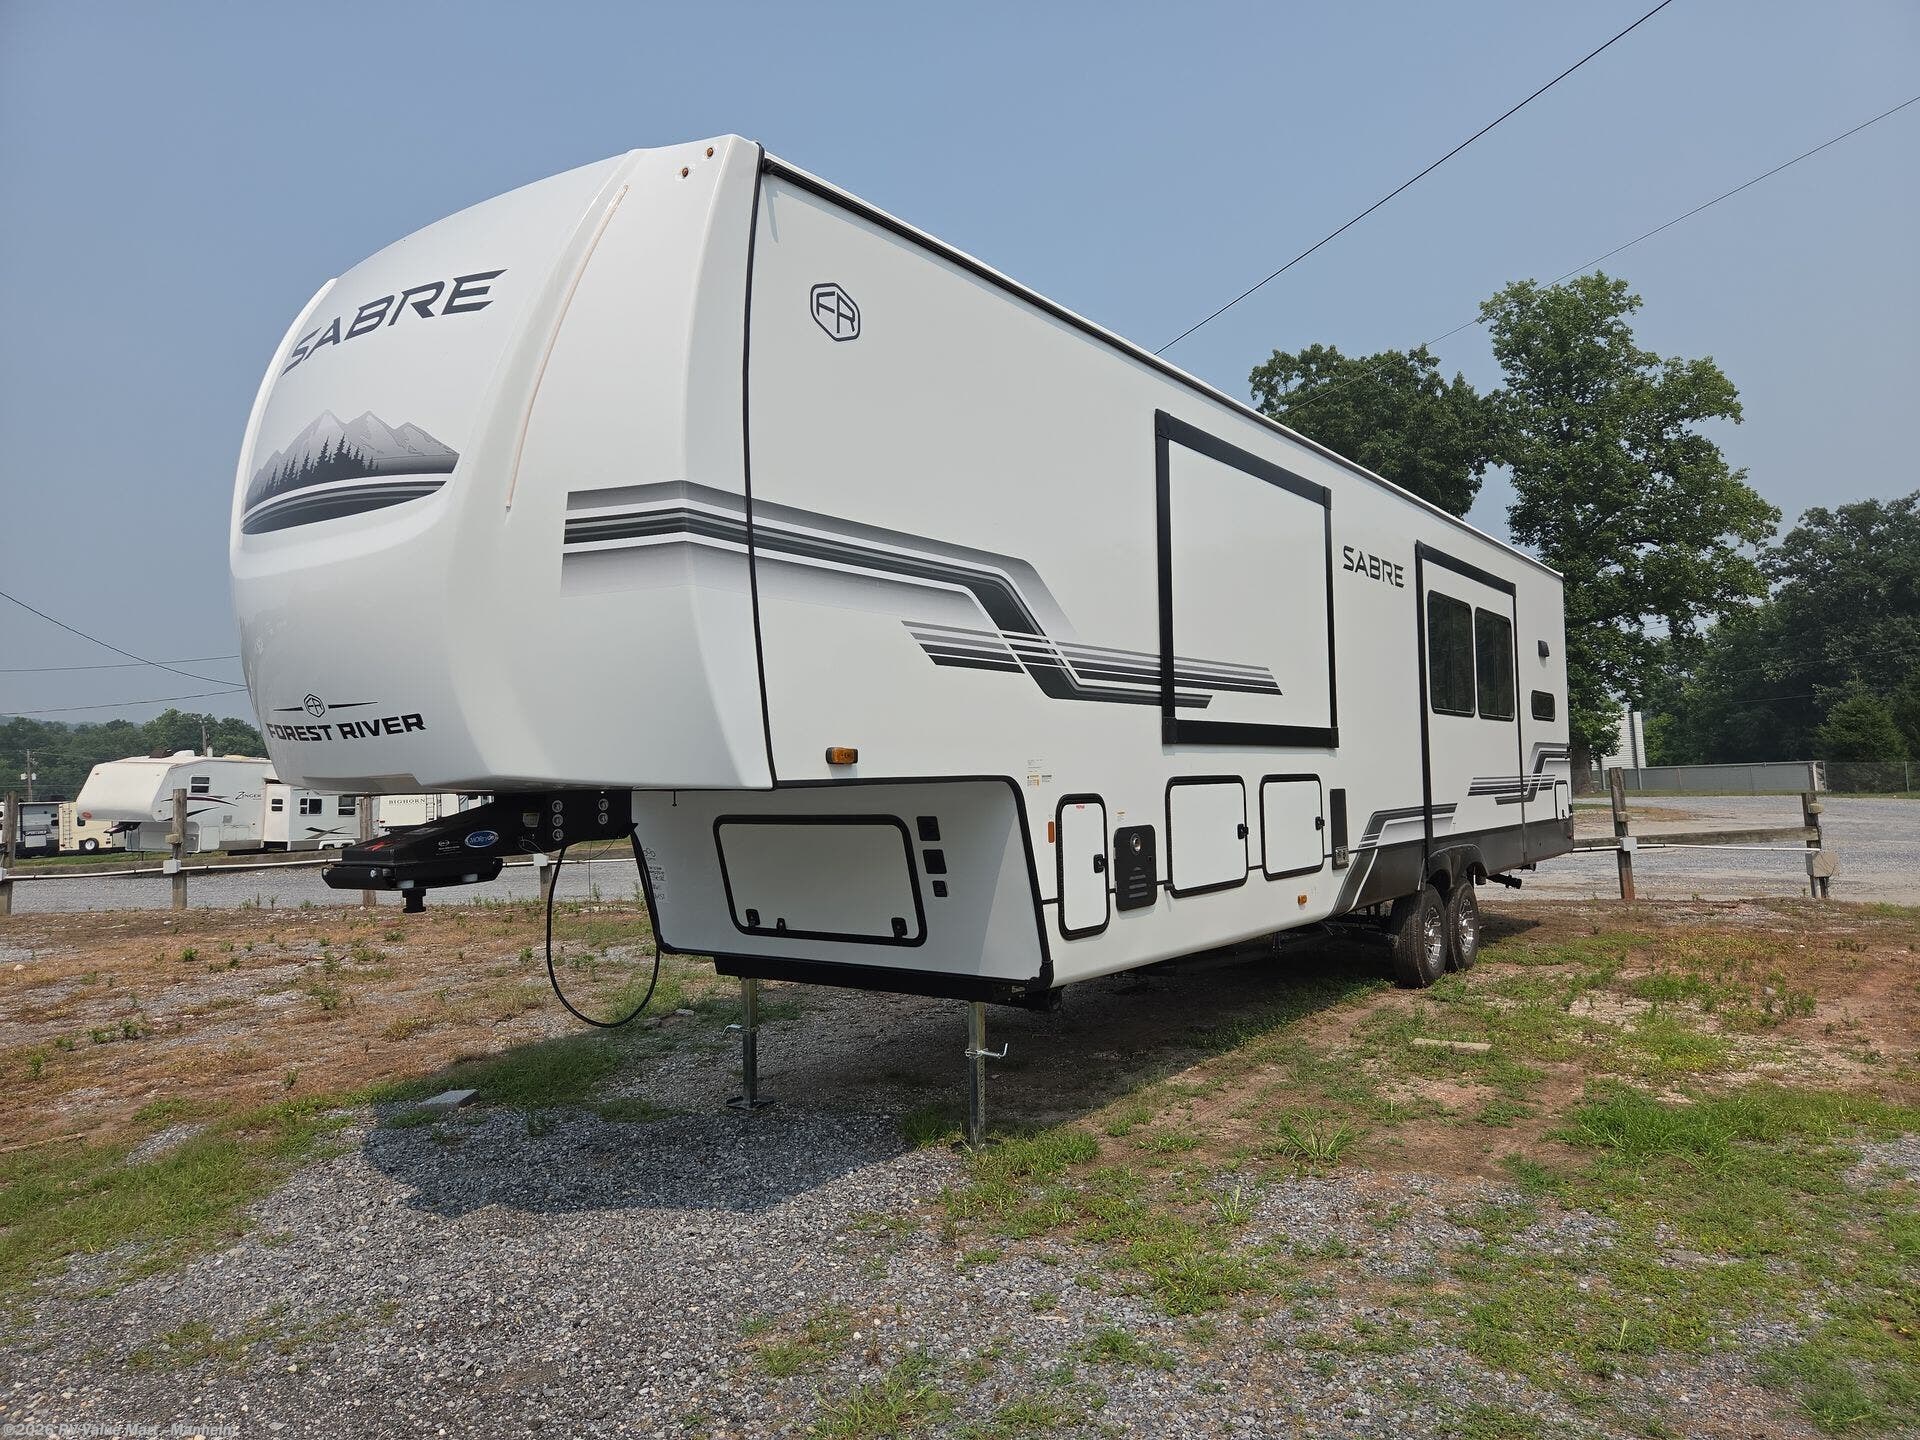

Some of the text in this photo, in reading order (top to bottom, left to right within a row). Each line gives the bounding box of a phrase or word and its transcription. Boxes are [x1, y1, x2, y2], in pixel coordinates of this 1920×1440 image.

[281, 268, 508, 377] SABRE
[1343, 545, 1404, 588] SABRE
[266, 713, 426, 741] FOREST RIVER
